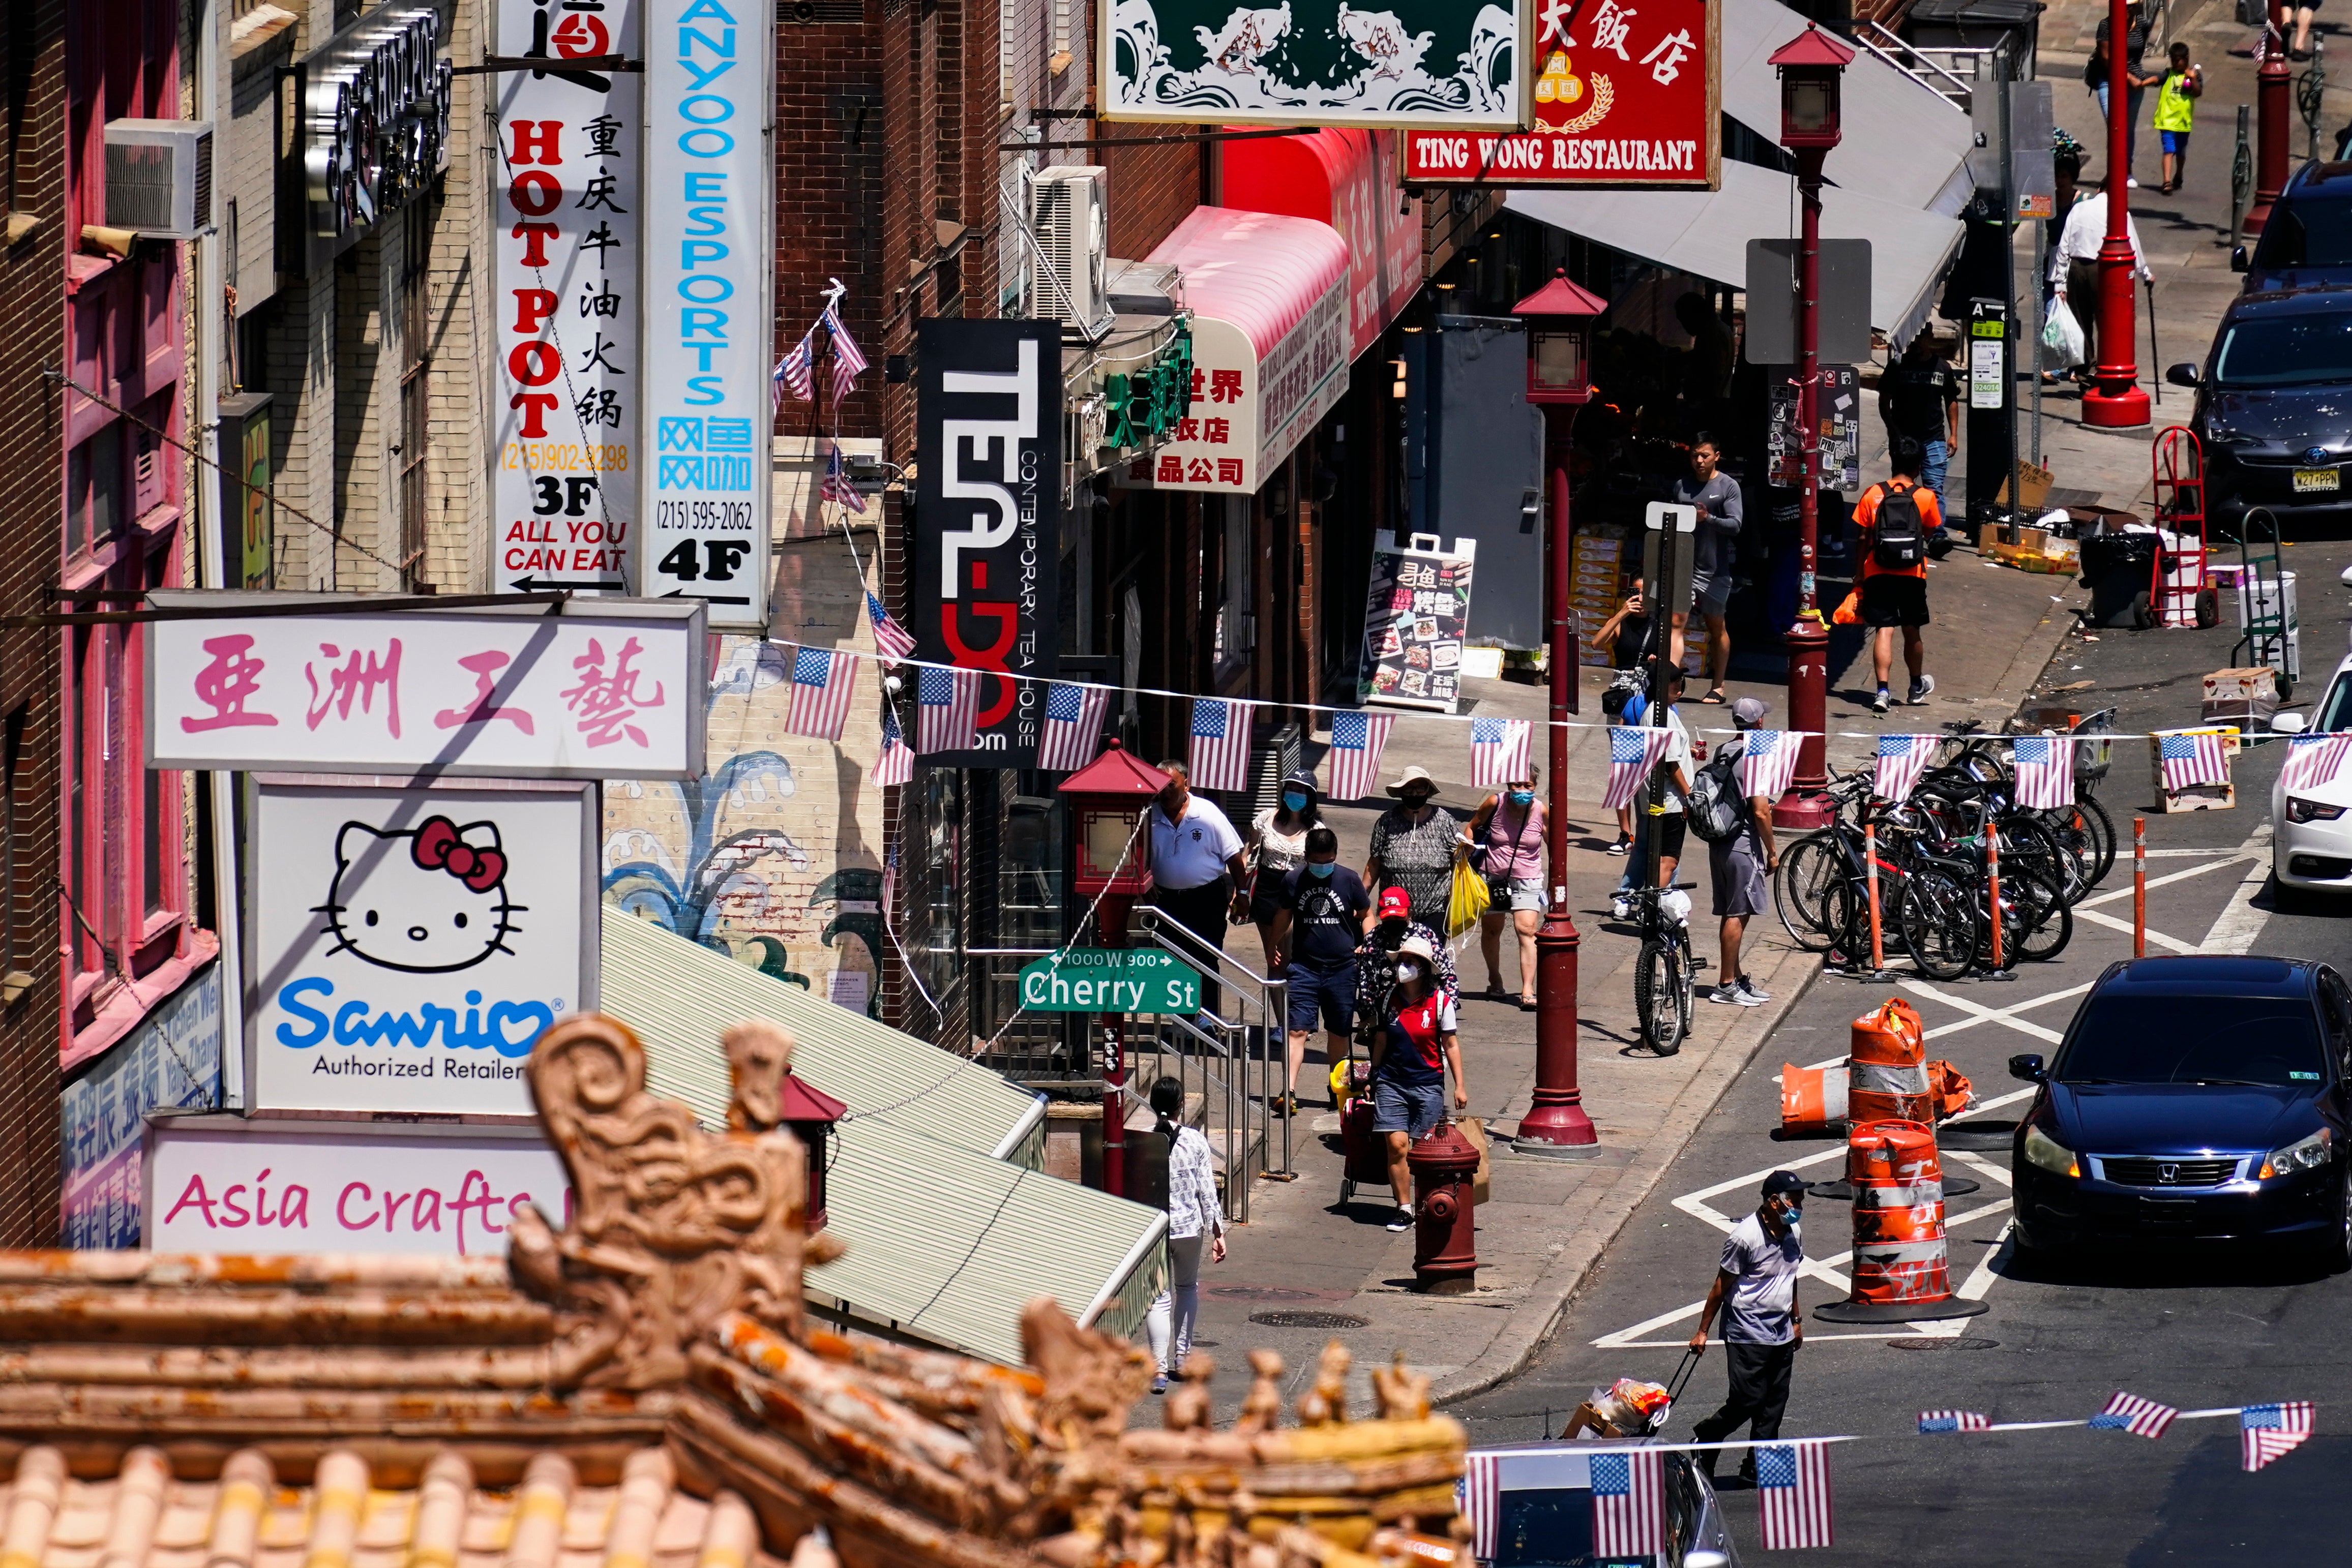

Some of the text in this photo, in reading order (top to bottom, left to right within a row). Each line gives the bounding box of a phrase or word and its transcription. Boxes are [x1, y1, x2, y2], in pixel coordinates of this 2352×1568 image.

[1416, 138, 1696, 171] TING WONG RESTAURANT
[509, 119, 563, 438] HOT POT
[575, 114, 628, 428] 重庆牛油火锅
[677, 172, 734, 406] ESPORTS
[1972, 303, 1983, 316] A
[1974, 383, 2000, 392] 924014
[1821, 441, 1835, 453] PYRO
[2320, 472, 2337, 485] PPN
[532, 475, 598, 517] 3F
[657, 500, 752, 530] (215) 595-2062
[505, 521, 627, 544] ALL YOU
[1019, 449, 1037, 621] CONTEMPORARY
[504, 548, 626, 571] CAN EAT
[658, 538, 751, 581] 4F
[1020, 629, 1035, 669] TEA
[1298, 887, 1345, 912] ABERCROMBIE
[1065, 952, 1156, 968] 1000 W 900
[1024, 971, 1194, 1011] Cherry St
[189, 1030, 219, 1070] Zhang
[312, 1054, 522, 1080] Authorized Retailer
